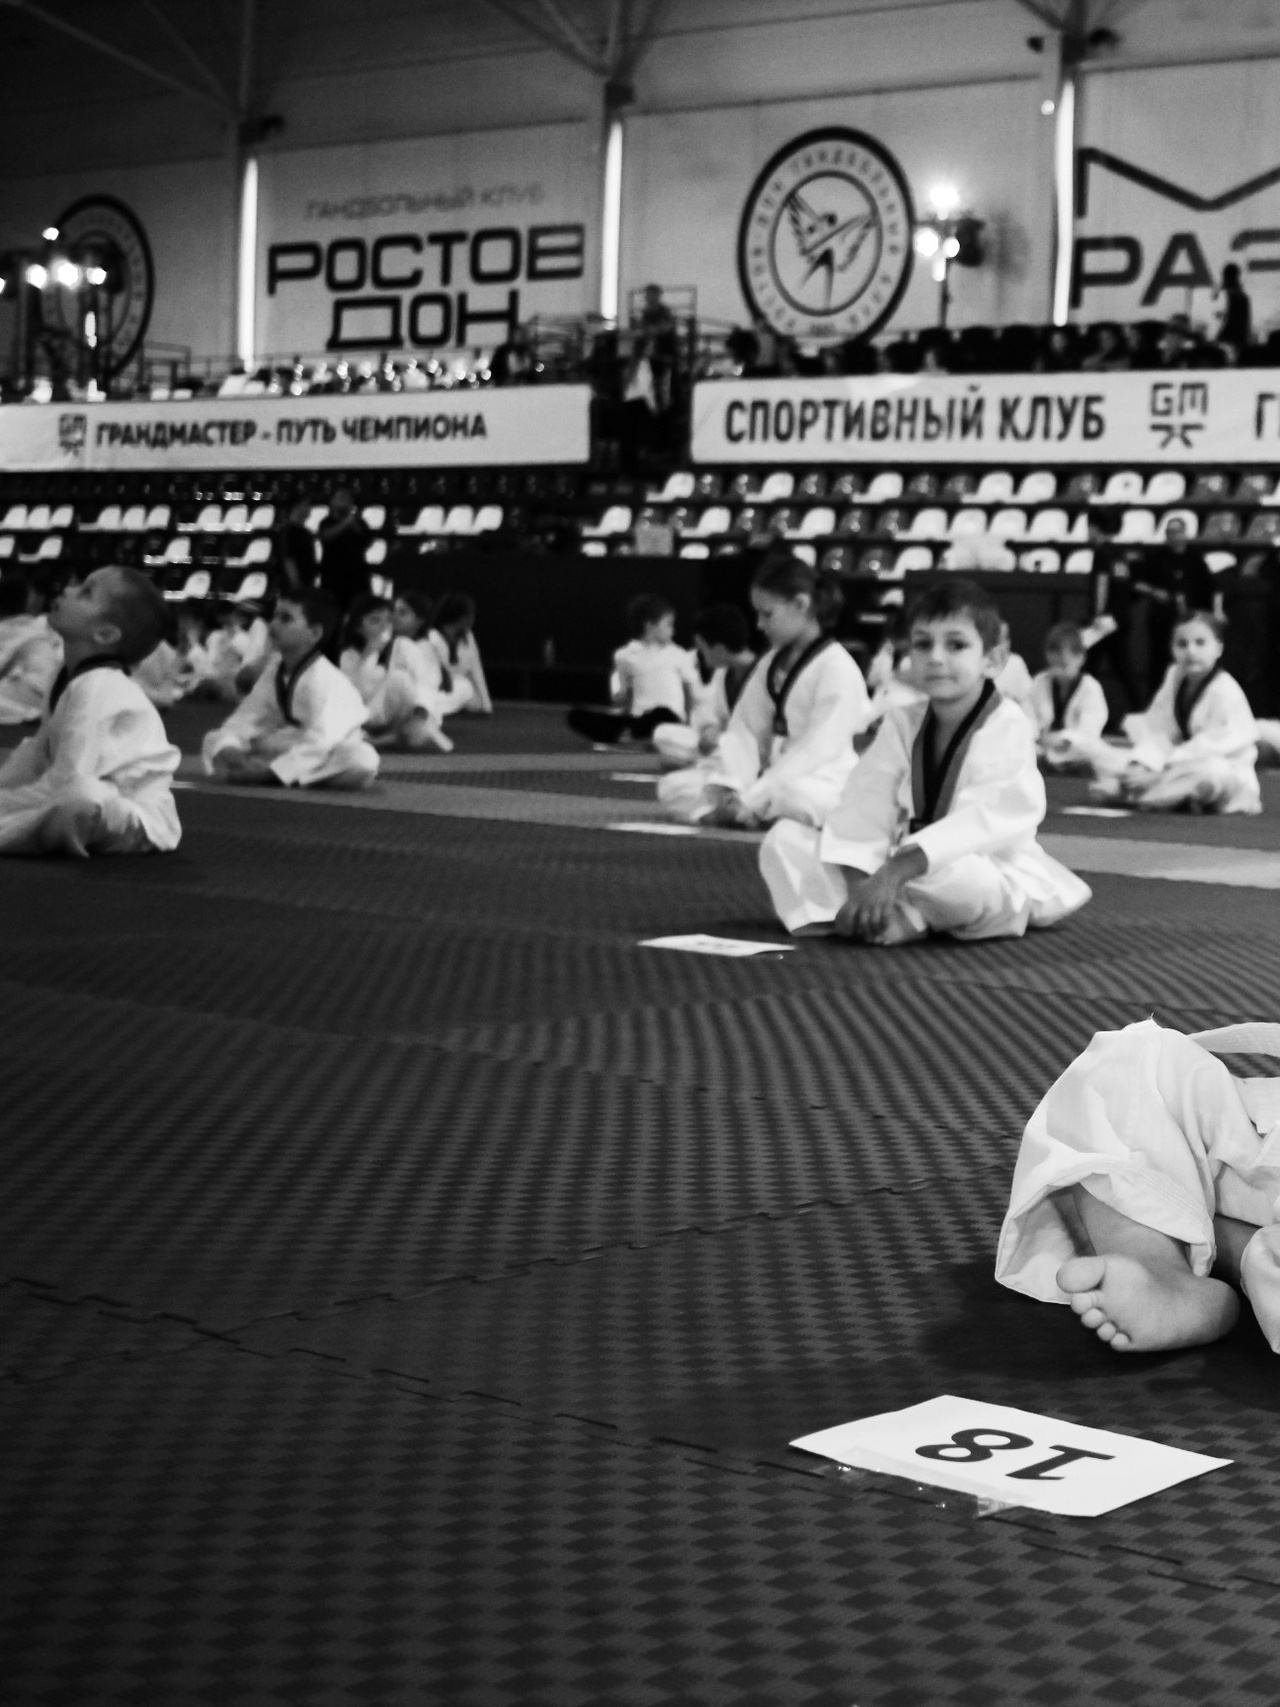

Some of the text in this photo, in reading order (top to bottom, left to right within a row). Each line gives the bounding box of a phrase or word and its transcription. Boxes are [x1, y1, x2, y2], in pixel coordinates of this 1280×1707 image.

[267, 223, 585, 296] РОСТОВ
[325, 288, 519, 351] ДОН
[96, 419, 258, 449] ГРАНДМАСТЕР
[276, 417, 337, 445] ПУТЬ
[342, 412, 488, 442] ЧЕМПИОНА
[724, 384, 985, 444] СПОРТИВНЫЙ
[999, 394, 1106, 442] КЛУБ
[915, 1427, 1116, 1481] 18
